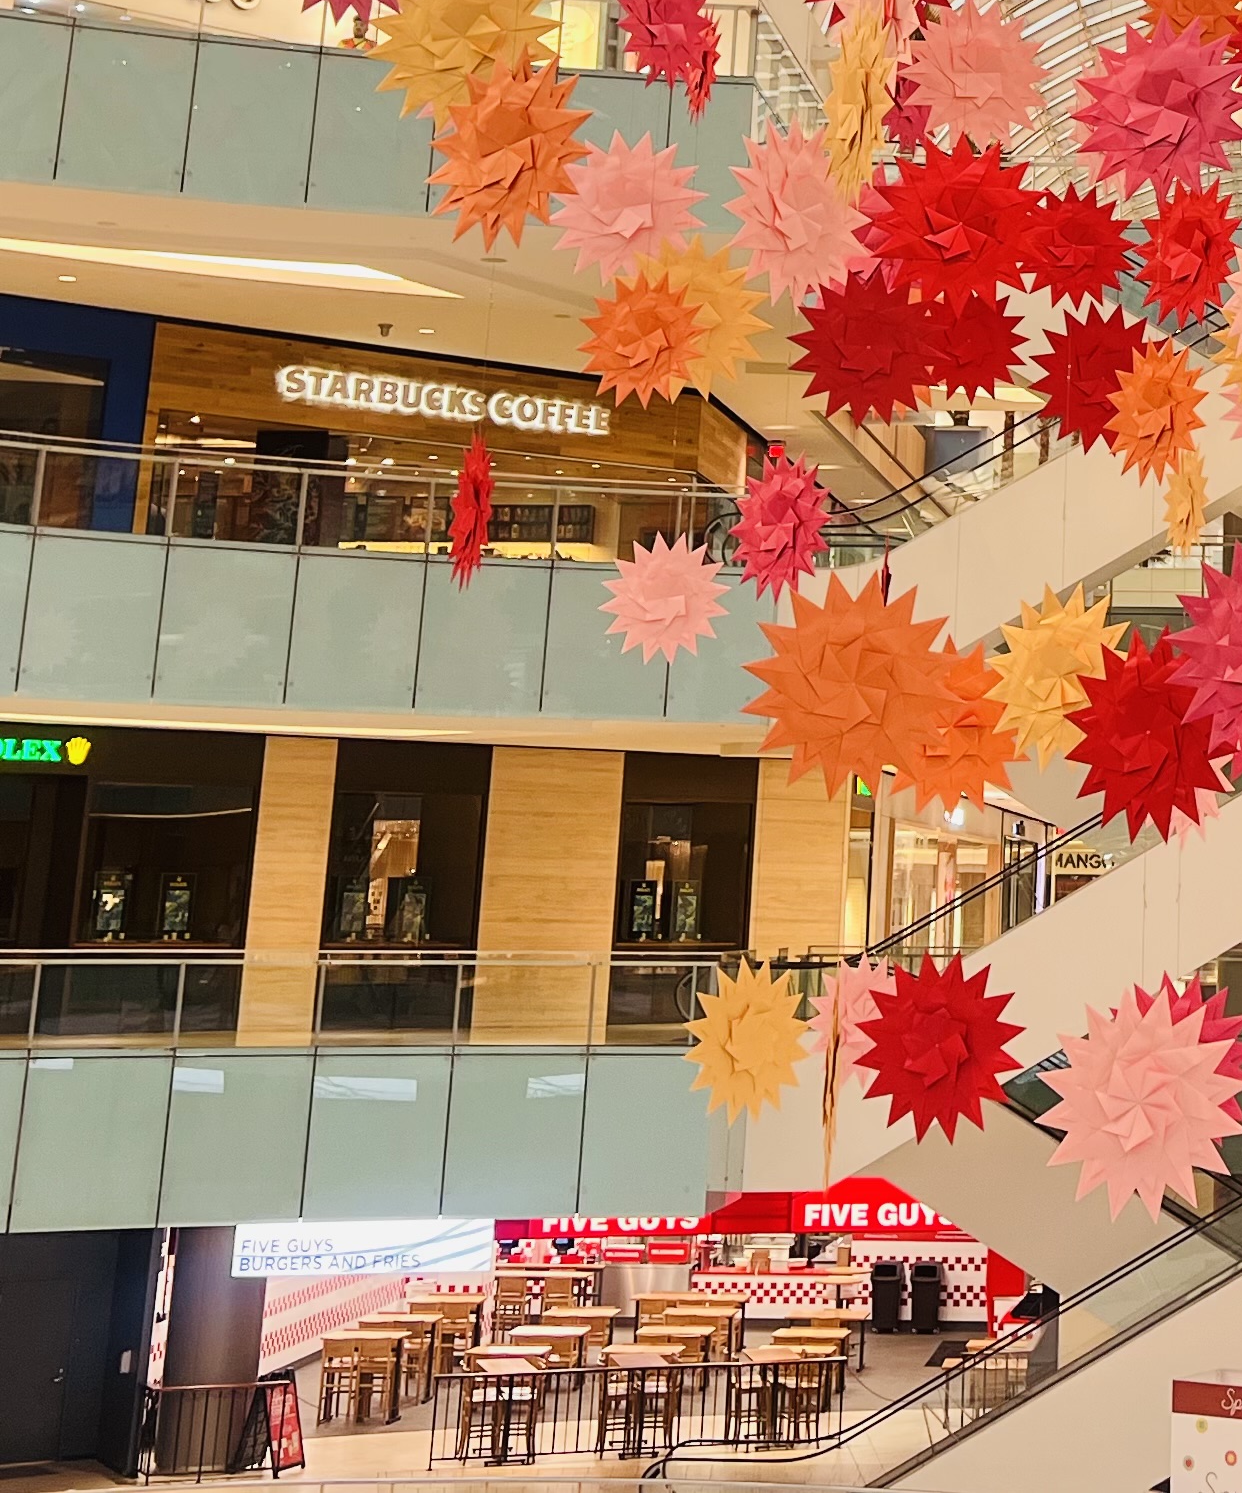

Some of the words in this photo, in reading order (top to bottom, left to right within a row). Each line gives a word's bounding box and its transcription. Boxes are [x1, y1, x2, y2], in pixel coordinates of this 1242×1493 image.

[283, 367, 488, 420] STARBUCKS
[494, 392, 613, 435] COFFEE
[0, 737, 62, 763] LEX
[542, 1216, 609, 1233] FIVE
[804, 1203, 869, 1227] FIVE
[241, 1238, 280, 1254] FIVE
[287, 1238, 334, 1253] GUYS
[239, 1255, 323, 1272] BURGERS
[329, 1254, 367, 1270] AND
[372, 1253, 422, 1269] FRIES
